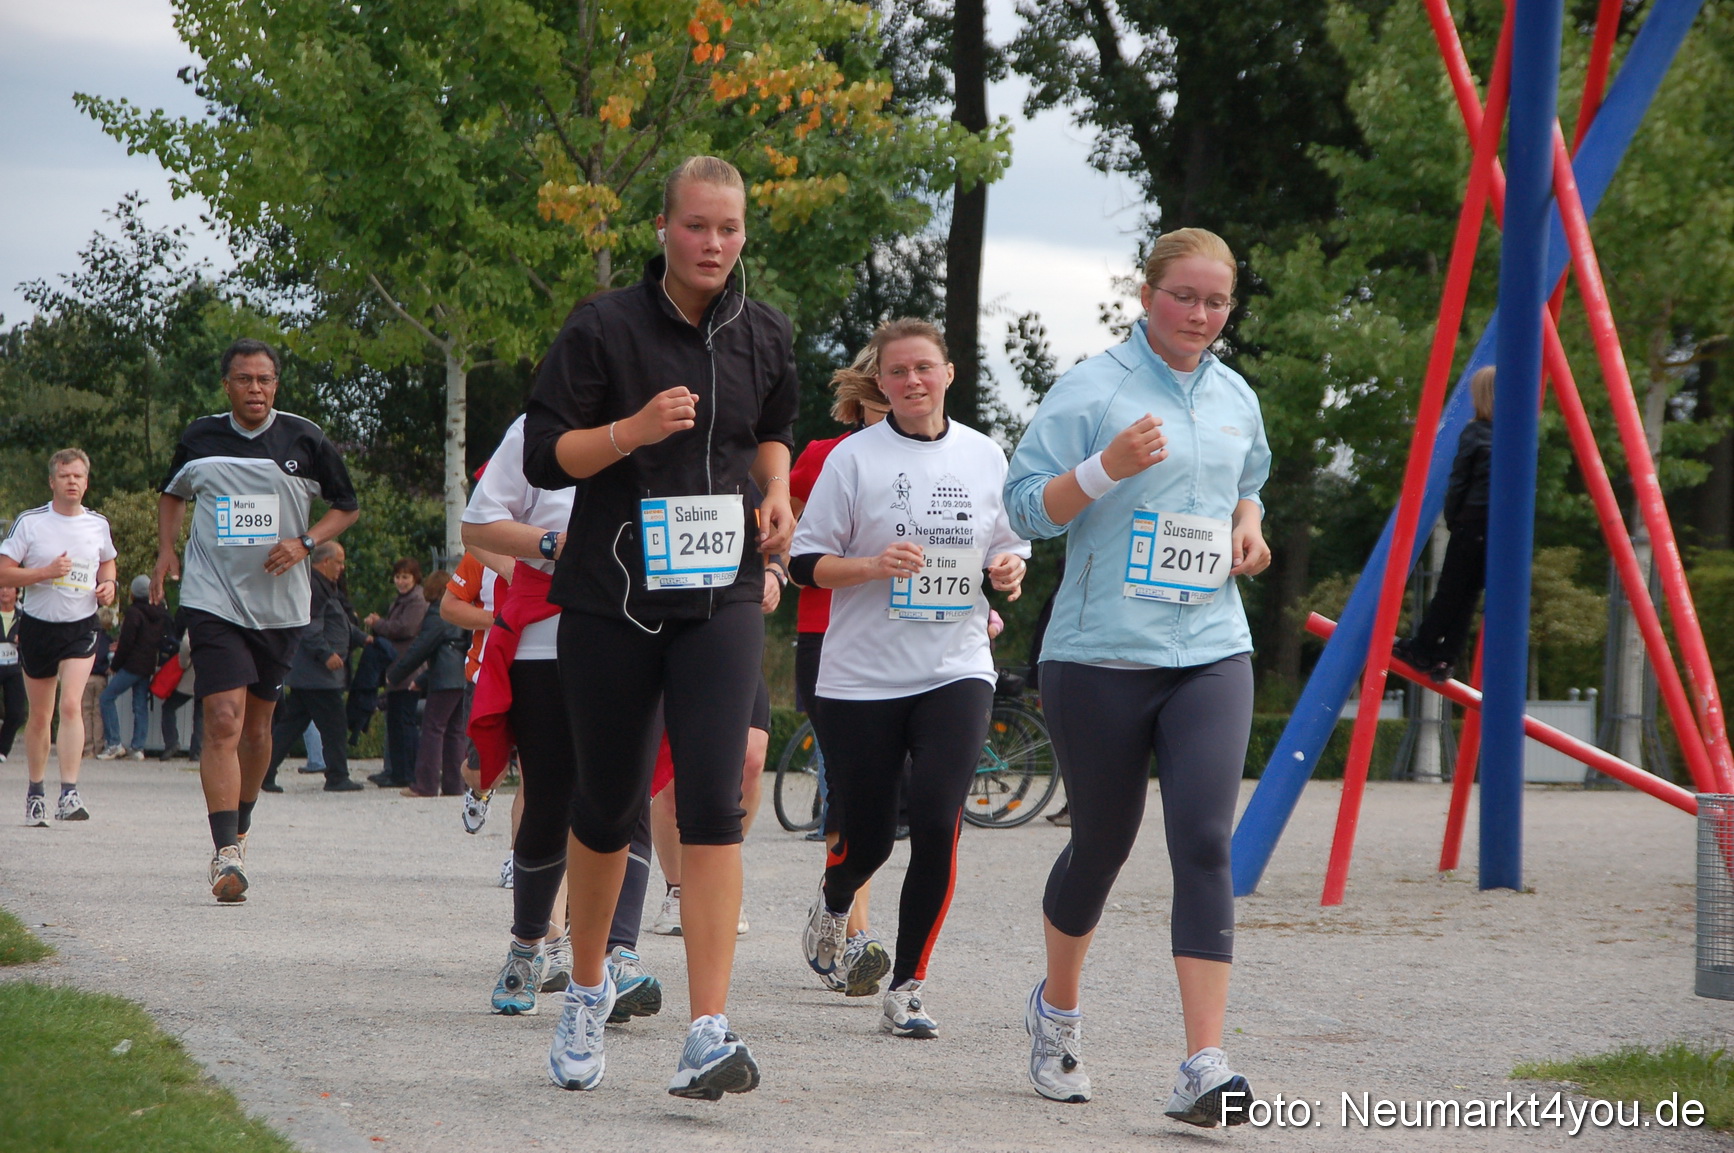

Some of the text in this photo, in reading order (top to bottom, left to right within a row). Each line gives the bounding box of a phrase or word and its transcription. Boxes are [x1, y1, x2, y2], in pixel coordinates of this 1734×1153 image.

[234, 500, 256, 509] Mario
[931, 500, 972, 508] 21.09.2008
[675, 505, 718, 522] Sabine
[235, 514, 272, 527] 2989
[915, 526, 974, 536] Neumarkter
[1163, 520, 1213, 541] Susanne
[652, 533, 659, 545] C
[679, 531, 736, 555] 2487
[929, 536, 974, 545] Stadtlauf
[1136, 541, 1144, 553] C
[1160, 546, 1221, 574] 2017
[918, 576, 971, 595] 3176
